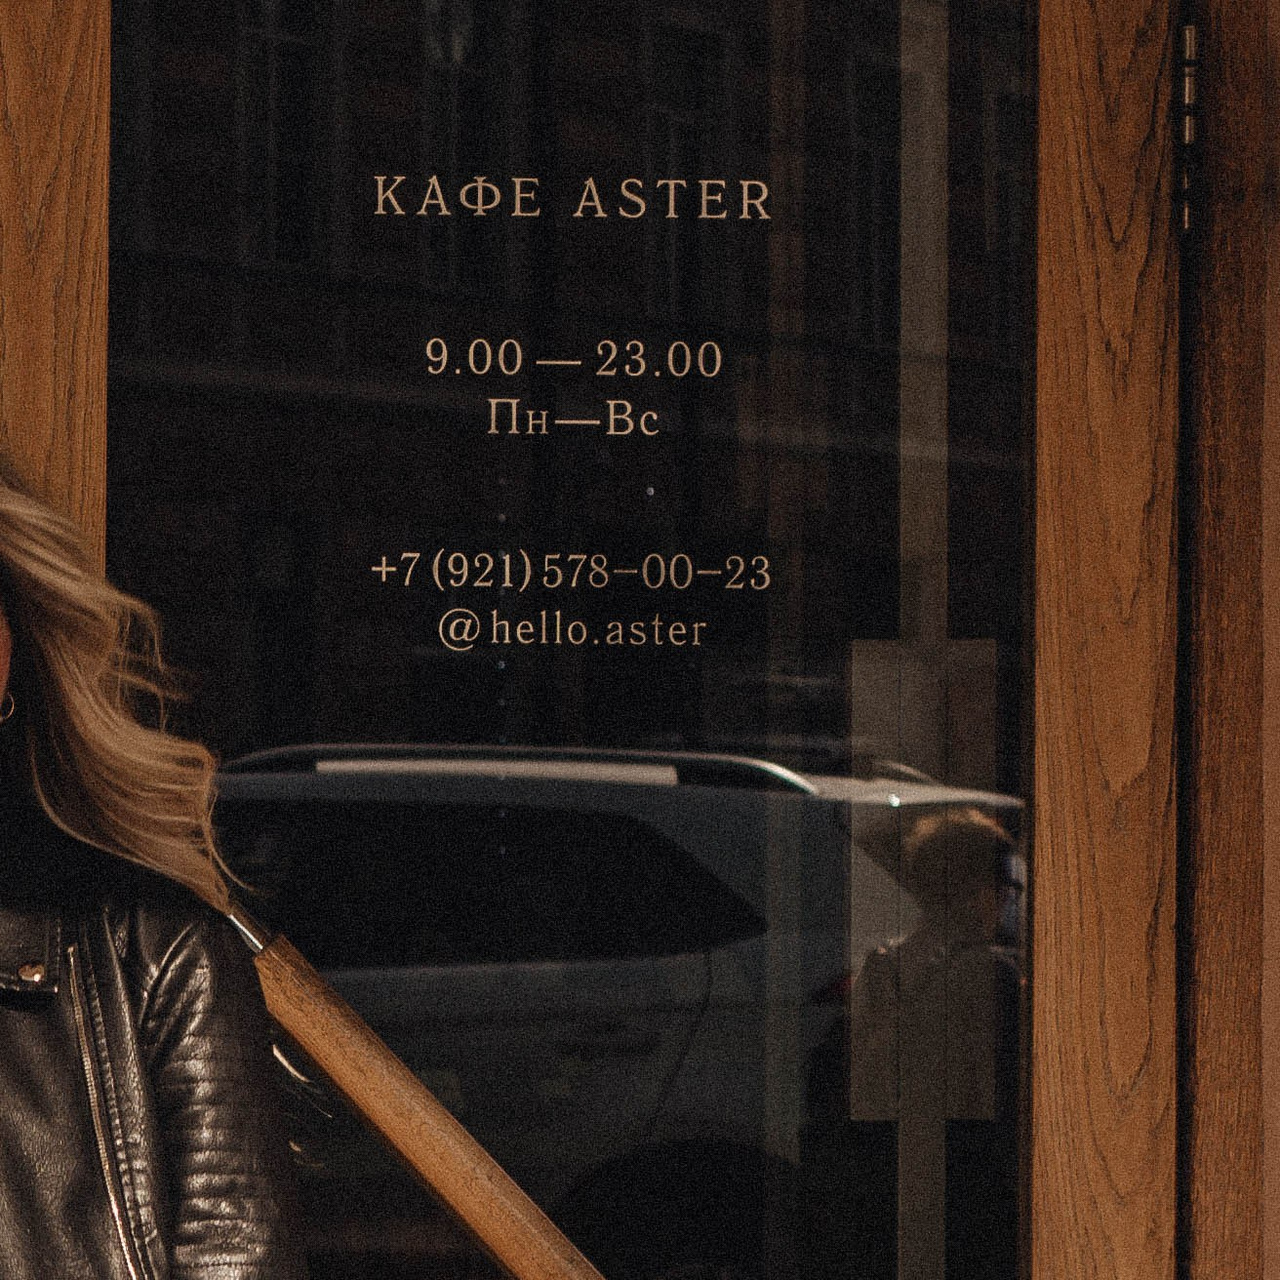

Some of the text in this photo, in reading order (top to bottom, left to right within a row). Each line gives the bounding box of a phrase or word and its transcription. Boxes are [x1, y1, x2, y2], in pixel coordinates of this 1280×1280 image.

[374, 175, 771, 219] КАФЕ ASTER
[426, 337, 522, 375] 9.00
[596, 340, 722, 377] 23.00
[438, 608, 707, 651] @hello.aster
